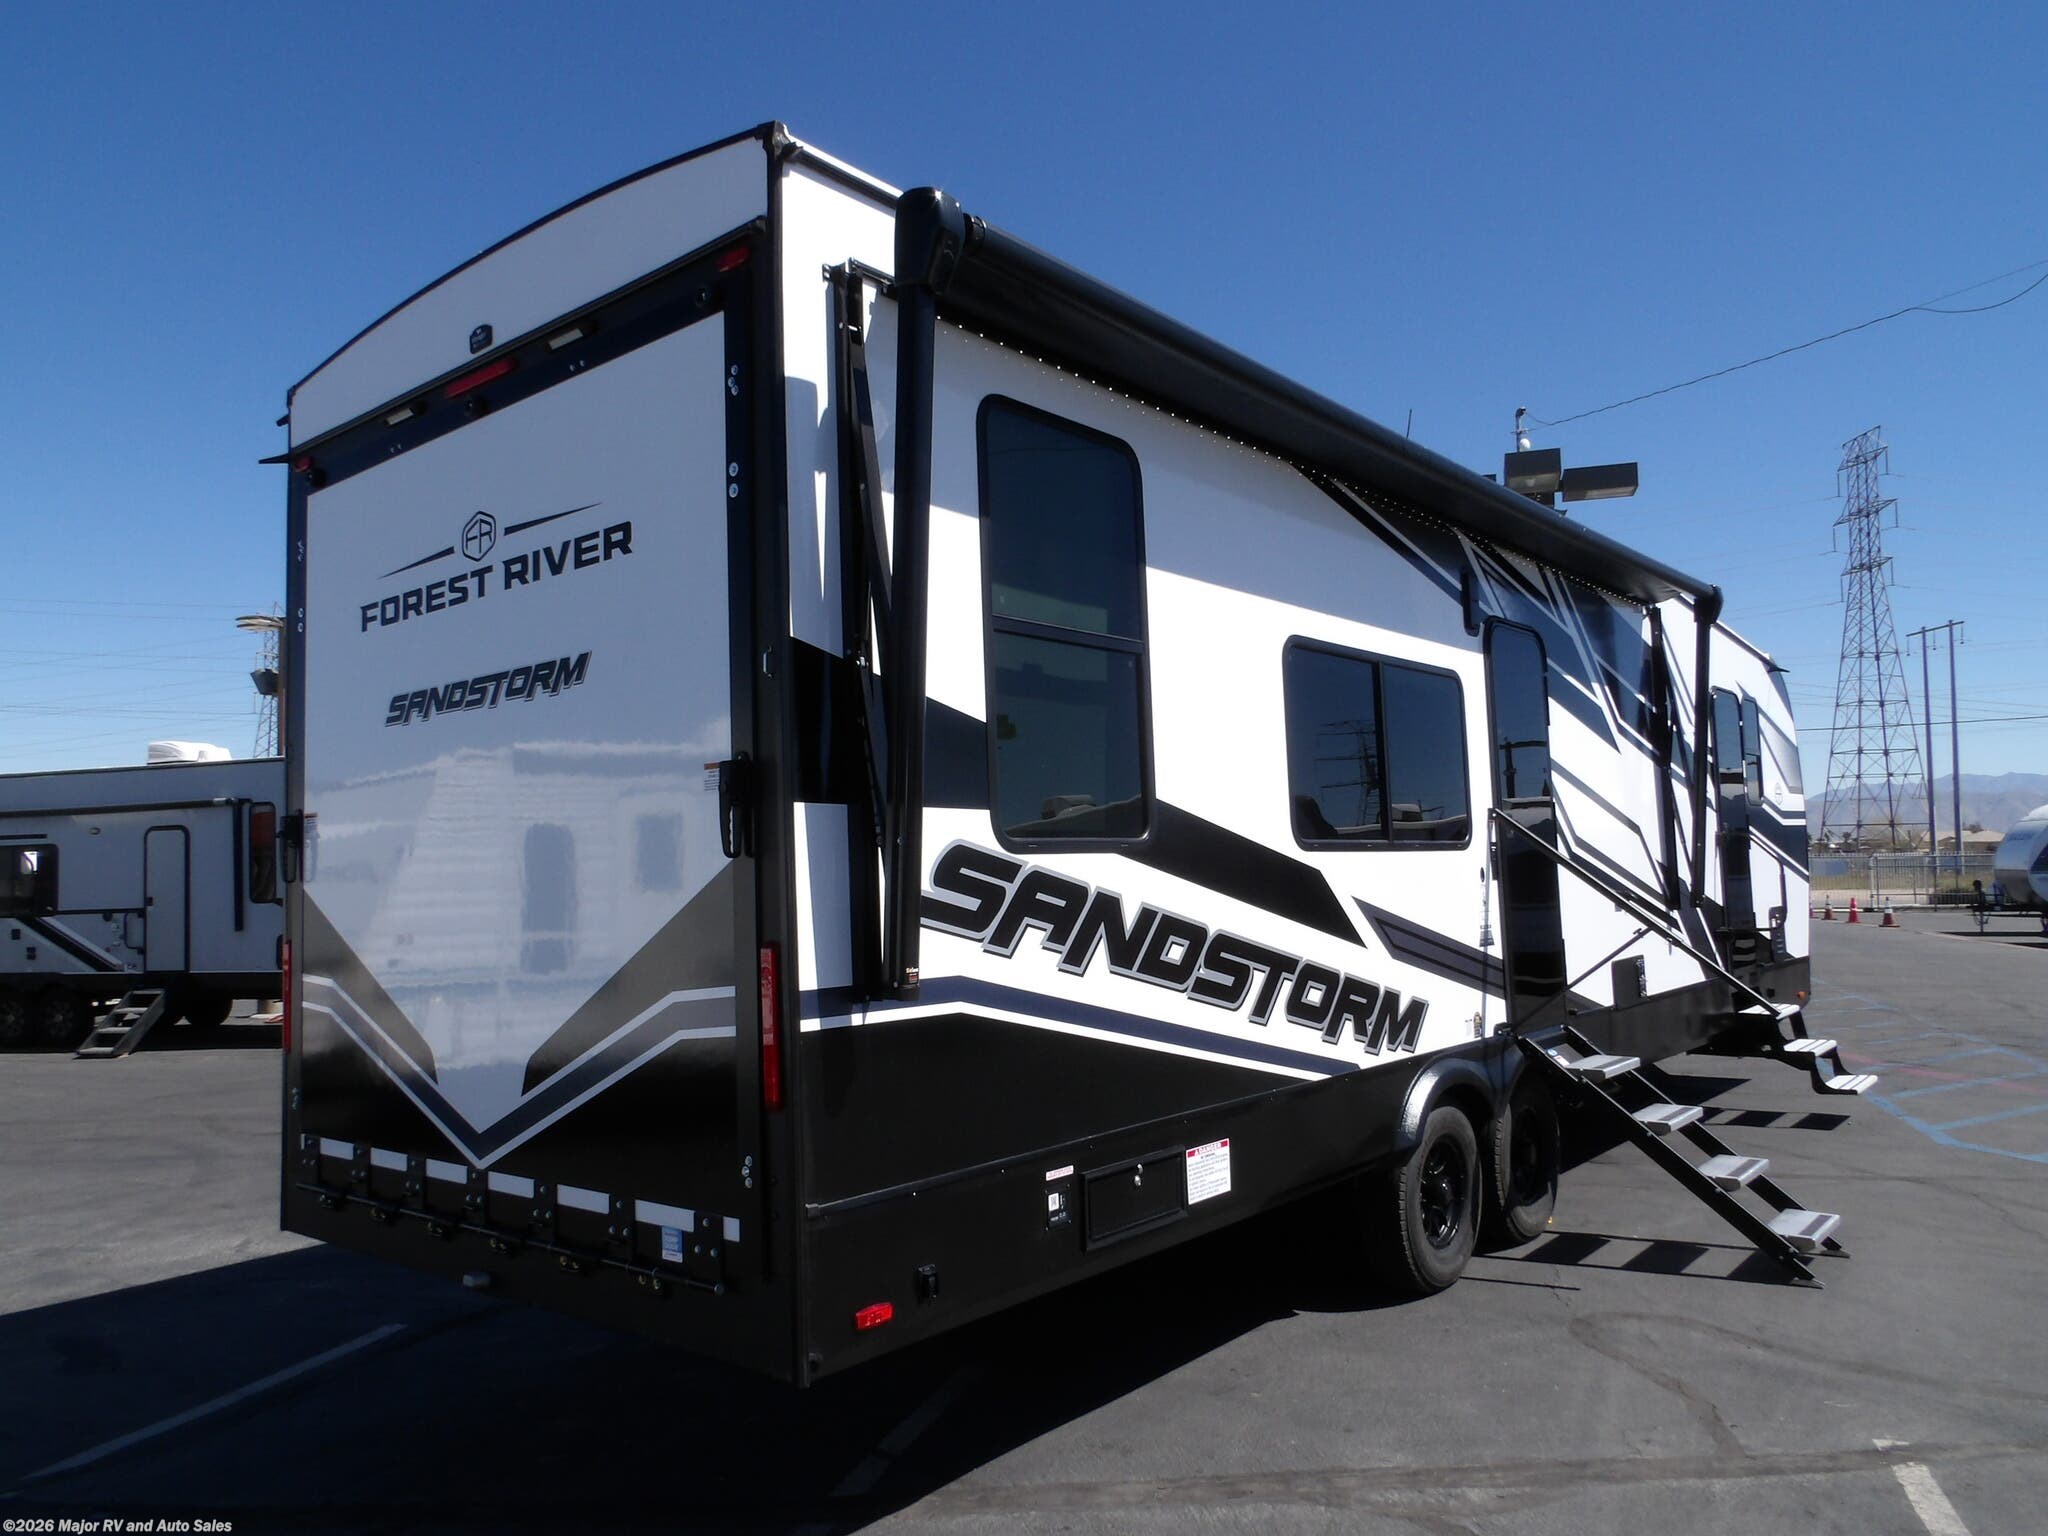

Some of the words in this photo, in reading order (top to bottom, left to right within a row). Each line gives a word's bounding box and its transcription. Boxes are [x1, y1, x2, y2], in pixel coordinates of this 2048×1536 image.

[360, 564, 494, 633] FOREST
[502, 520, 633, 590] RIVER
[384, 650, 593, 727] SANDSTORM
[921, 839, 1430, 1055] SANDSTORM
